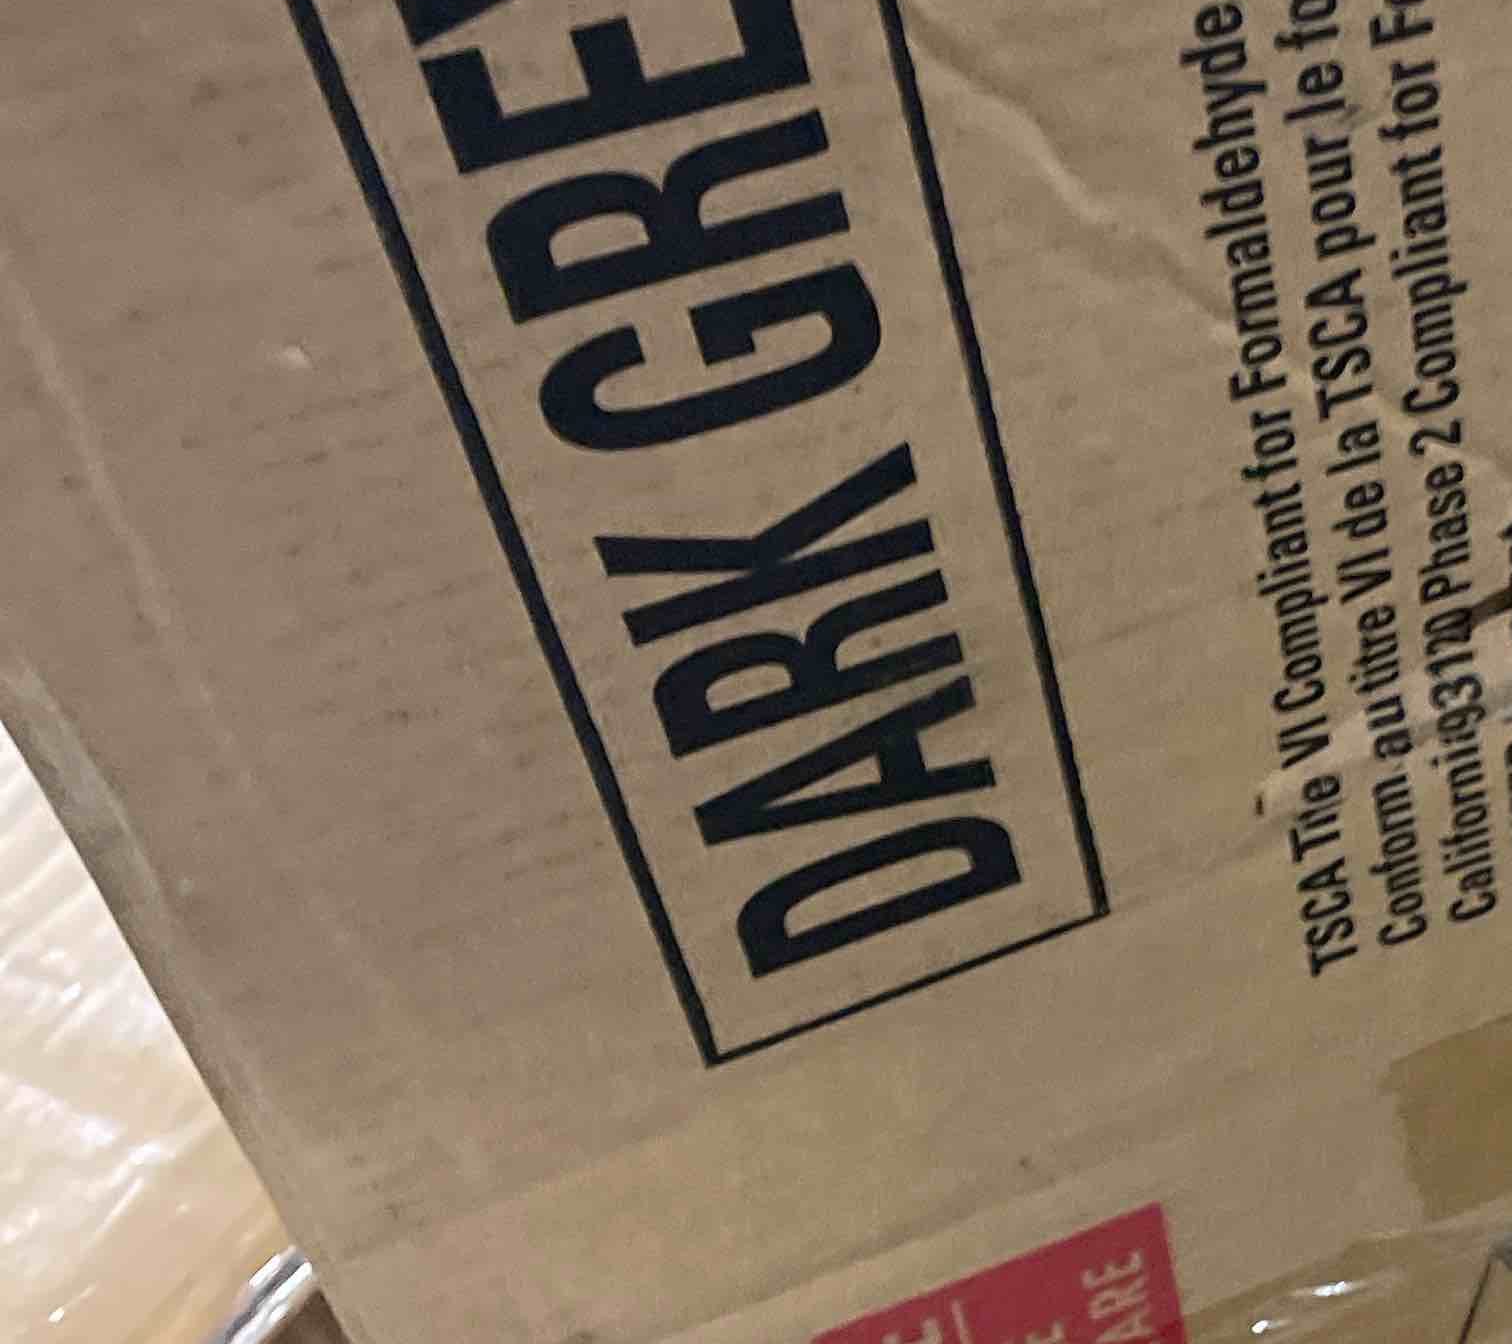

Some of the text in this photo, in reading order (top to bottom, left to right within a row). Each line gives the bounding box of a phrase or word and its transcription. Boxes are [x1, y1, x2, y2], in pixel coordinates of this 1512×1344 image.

[1283, 60, 1344, 128] le
[1377, 59, 1439, 143] for
[1304, 133, 1377, 259] pour
[1390, 143, 1468, 416] Compliant
[1305, 267, 1375, 423] TSCA
[1240, 407, 1298, 481] for
[1325, 419, 1382, 477] la
[1408, 417, 1463, 458] 2
[1331, 480, 1389, 543] de
[1419, 460, 1473, 605] Phase
[1254, 477, 1330, 720] Compliant
[1335, 548, 1395, 606] VI
[1346, 602, 1406, 706] titre
[594, 441, 1025, 981] DARK
[1278, 720, 1331, 770] VI
[1365, 704, 1413, 763] au
[1369, 764, 1428, 949] Conform
[1296, 856, 1359, 977] TSCA
